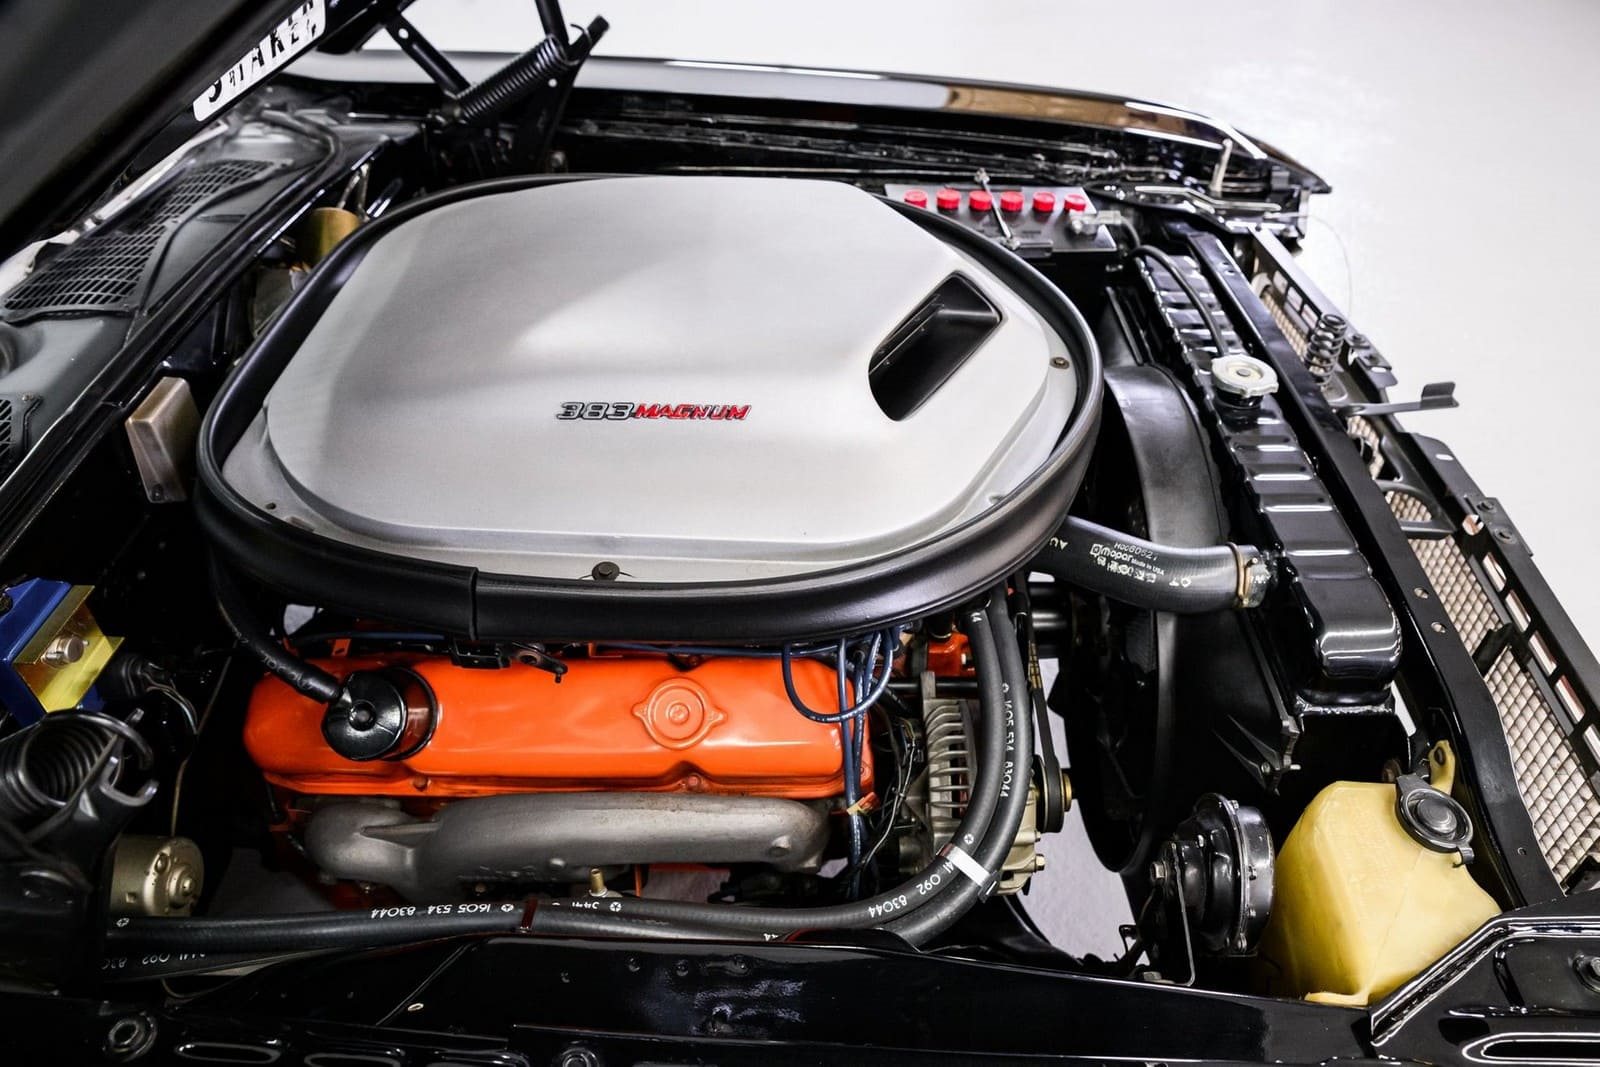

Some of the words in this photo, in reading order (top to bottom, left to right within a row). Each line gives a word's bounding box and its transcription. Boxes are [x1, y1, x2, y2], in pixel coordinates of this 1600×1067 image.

[370, 906, 416, 919] 83044
[427, 904, 453, 915] 534
[868, 894, 908, 918] 83044
